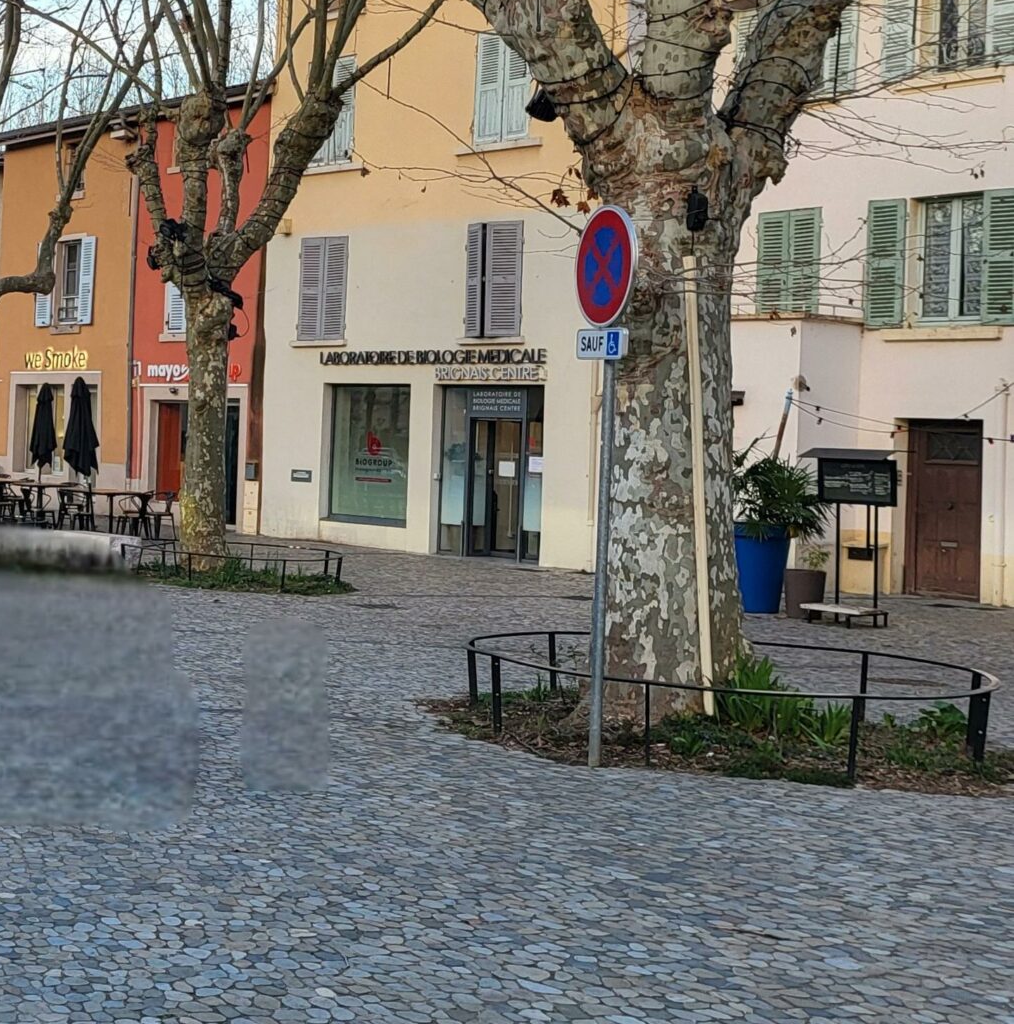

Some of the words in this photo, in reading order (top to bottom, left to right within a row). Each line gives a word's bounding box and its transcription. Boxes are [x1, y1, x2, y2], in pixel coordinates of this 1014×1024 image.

[581, 336, 604, 352] SAUF
[24, 352, 43, 369] we
[44, 345, 87, 370] Smoke
[320, 350, 397, 366] LABORATOIRE
[398, 350, 416, 365] DE
[416, 349, 476, 365] BIOLOGIE
[478, 348, 547, 365] MEDICALE
[435, 366, 490, 381] BRIGNAIS
[492, 366, 539, 381] CENTRE
